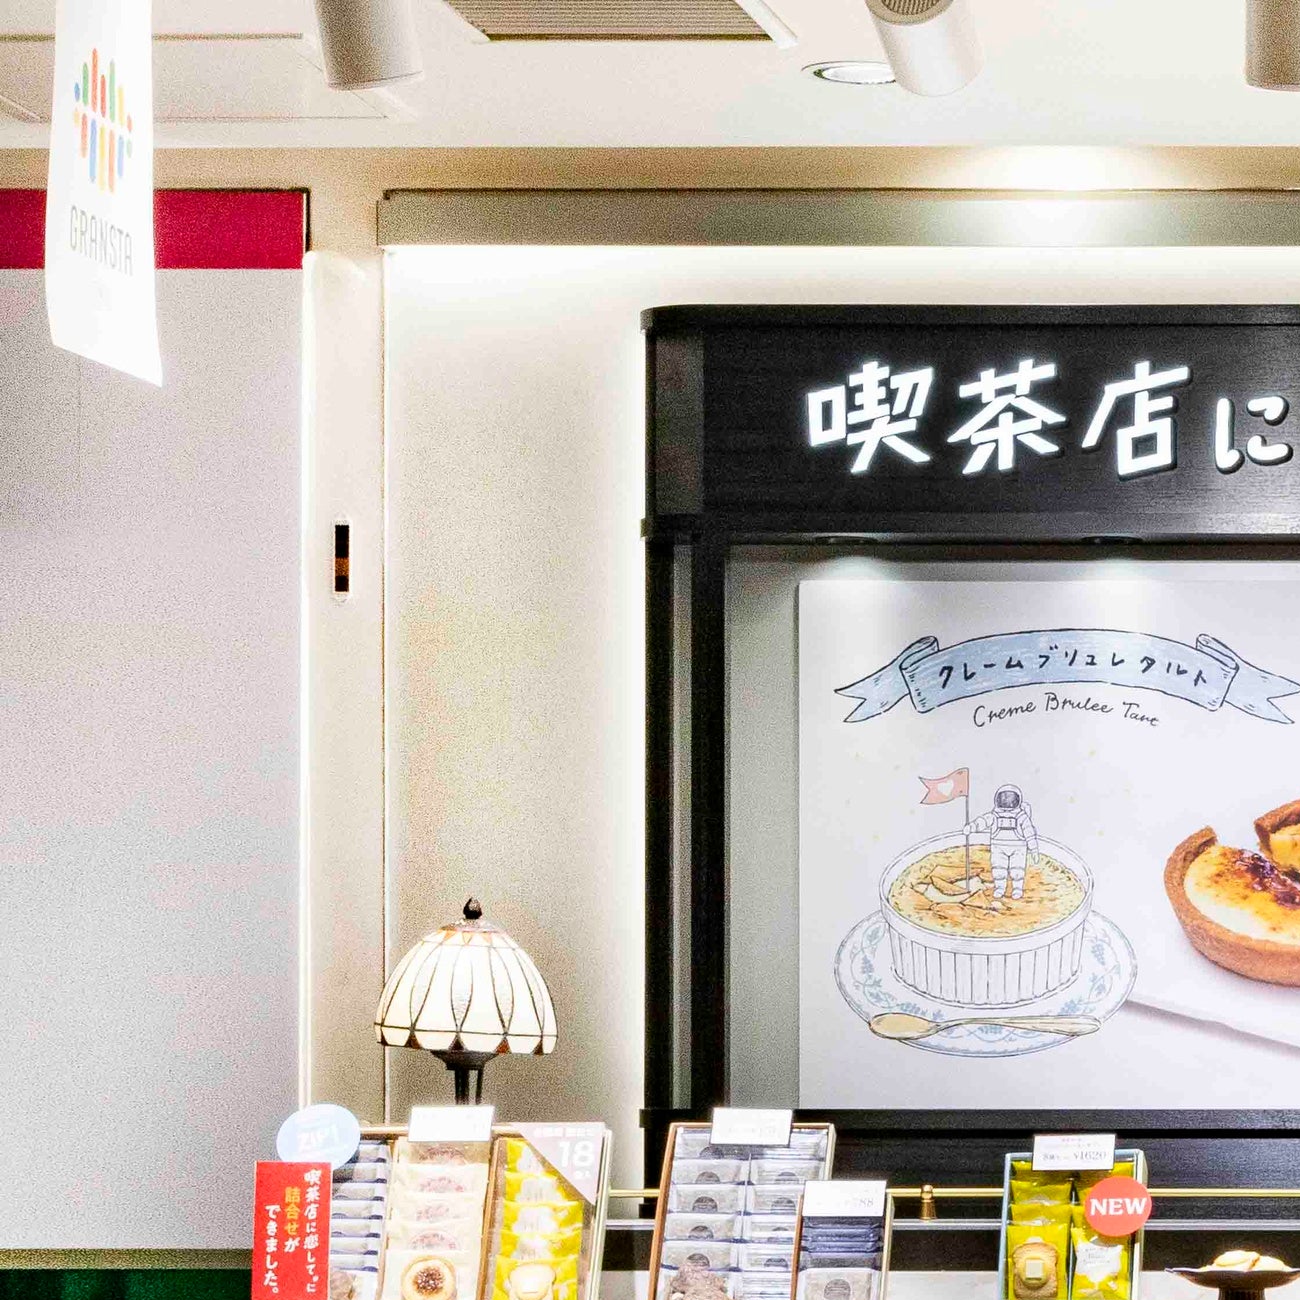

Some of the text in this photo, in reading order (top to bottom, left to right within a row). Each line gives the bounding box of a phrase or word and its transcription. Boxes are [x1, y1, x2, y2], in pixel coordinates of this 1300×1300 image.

[69, 203, 133, 278] GRANSTA
[972, 698, 1037, 729] Creme
[1044, 691, 1115, 718] Brulee
[284, 1186, 300, 1253] 詰合せが
[1089, 1197, 1147, 1217] NEW
[263, 1203, 281, 1295] できました。
